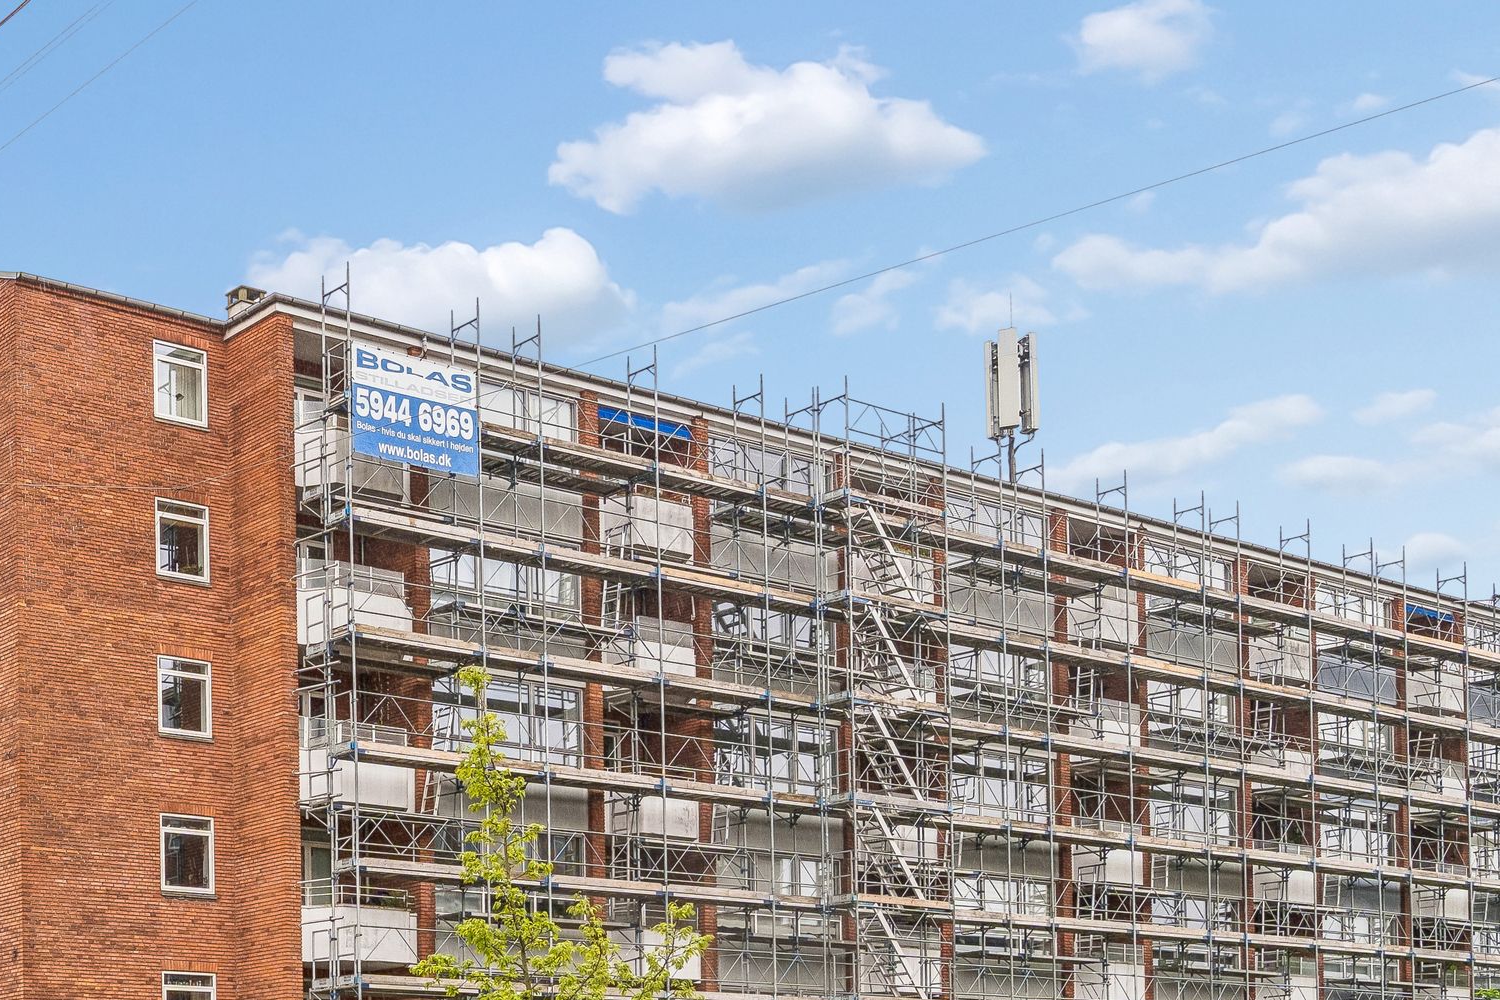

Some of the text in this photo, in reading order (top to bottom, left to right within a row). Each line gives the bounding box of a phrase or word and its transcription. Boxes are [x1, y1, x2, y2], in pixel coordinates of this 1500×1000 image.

[356, 348, 473, 393] BOLAS
[355, 387, 474, 440] 5944 6969
[356, 420, 376, 433] Bolas
[381, 427, 396, 437] hvis
[396, 430, 406, 439] du
[407, 433, 421, 443] skal
[423, 436, 445, 447] sikkert
[378, 442, 452, 467] www.bolas.dk
